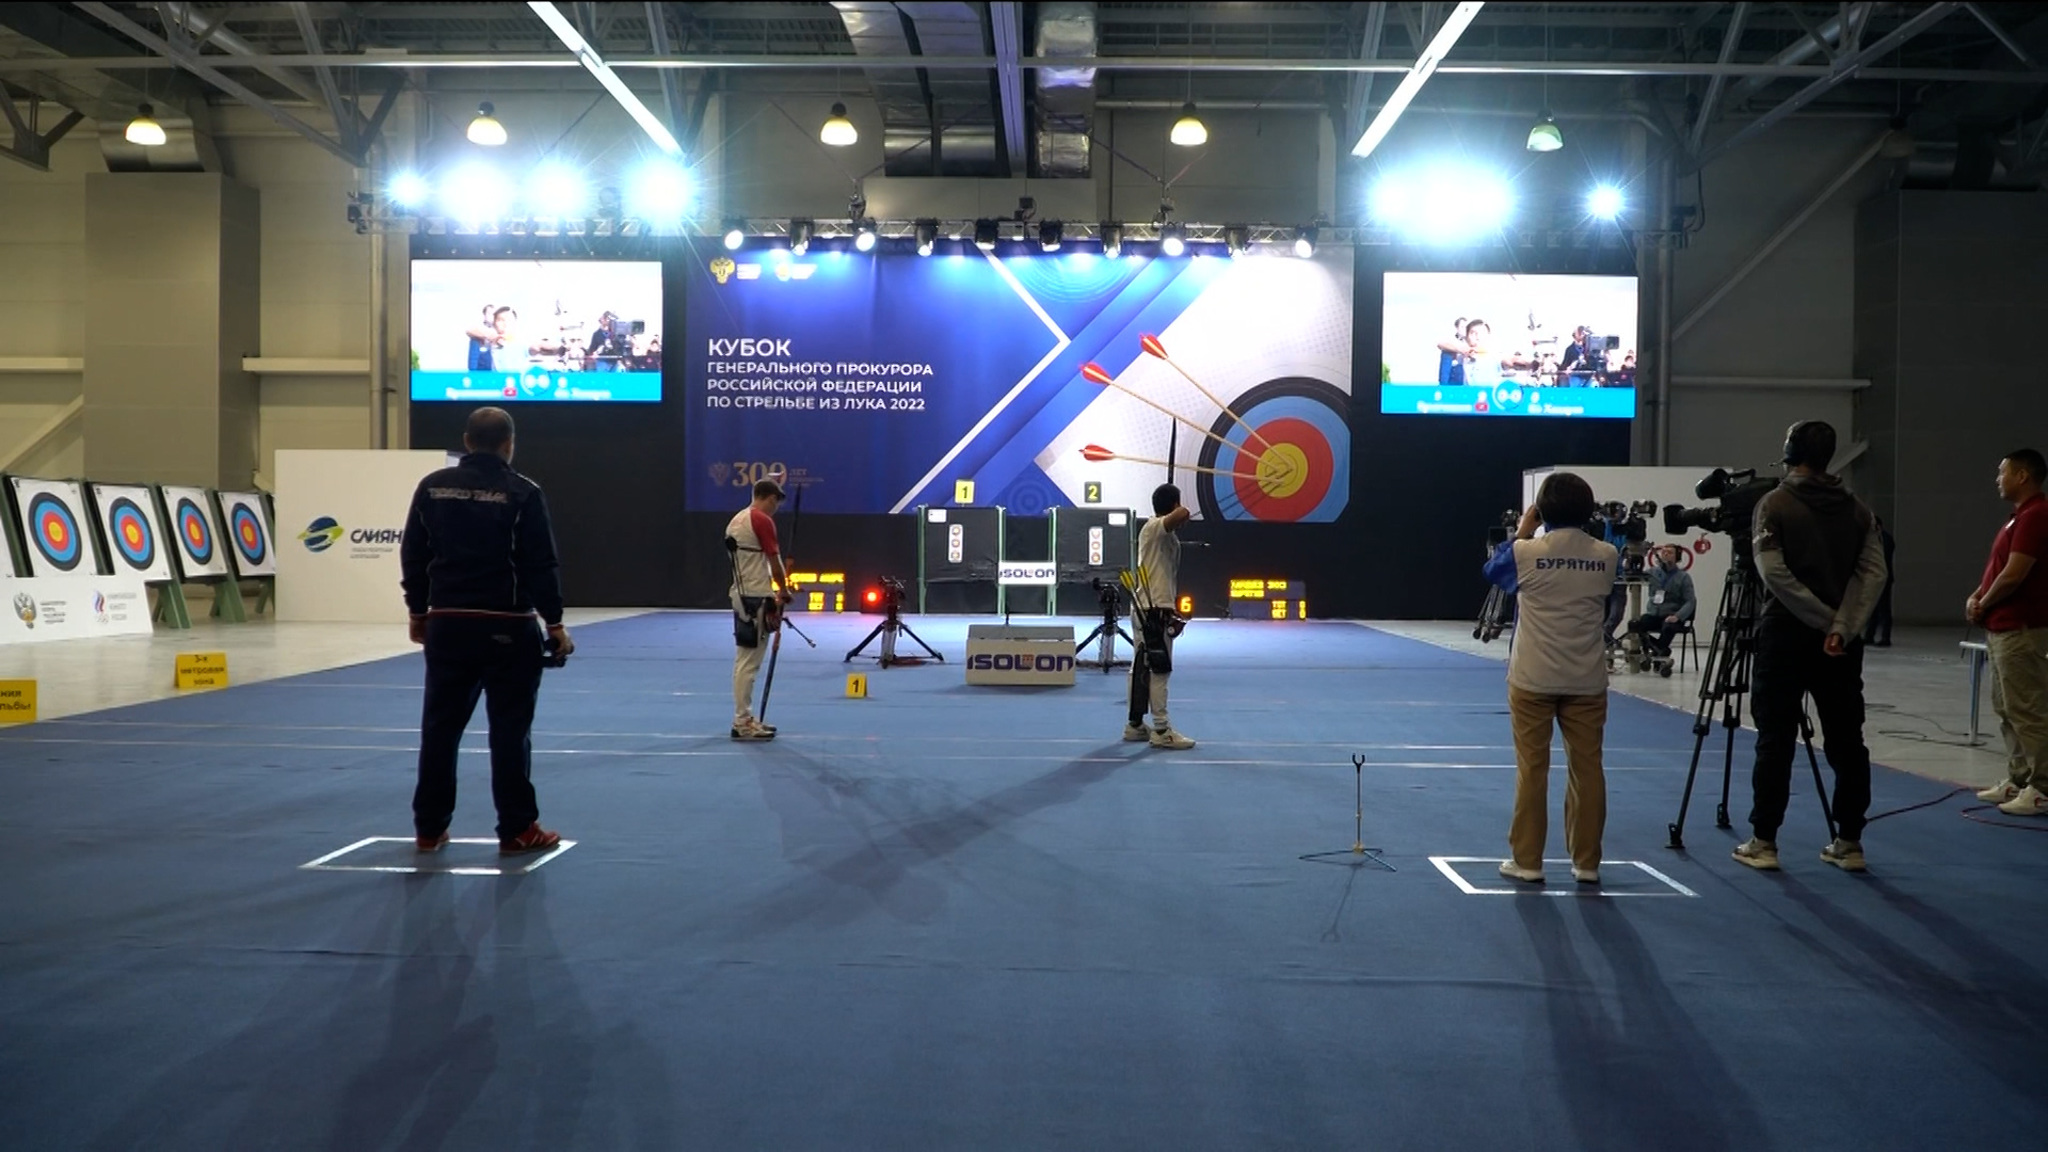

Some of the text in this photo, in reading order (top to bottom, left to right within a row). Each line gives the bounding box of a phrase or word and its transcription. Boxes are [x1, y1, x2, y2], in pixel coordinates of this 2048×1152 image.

[708, 338, 792, 357] КУБОК
[707, 361, 934, 376] ГЕНЕРАЛЬНОГО ПРОКУРОРА
[707, 377, 922, 394] РОССИЙСКОЙ ФЕДЕРАЦИИ
[707, 396, 926, 411] ПО СТРЕЛЬБЕ ИЗ ЛУКА 2022
[1088, 485, 1098, 500] 2
[1536, 558, 1606, 572] БУРЯТИЯ
[1180, 596, 1192, 612] 6
[852, 678, 860, 692] 1
